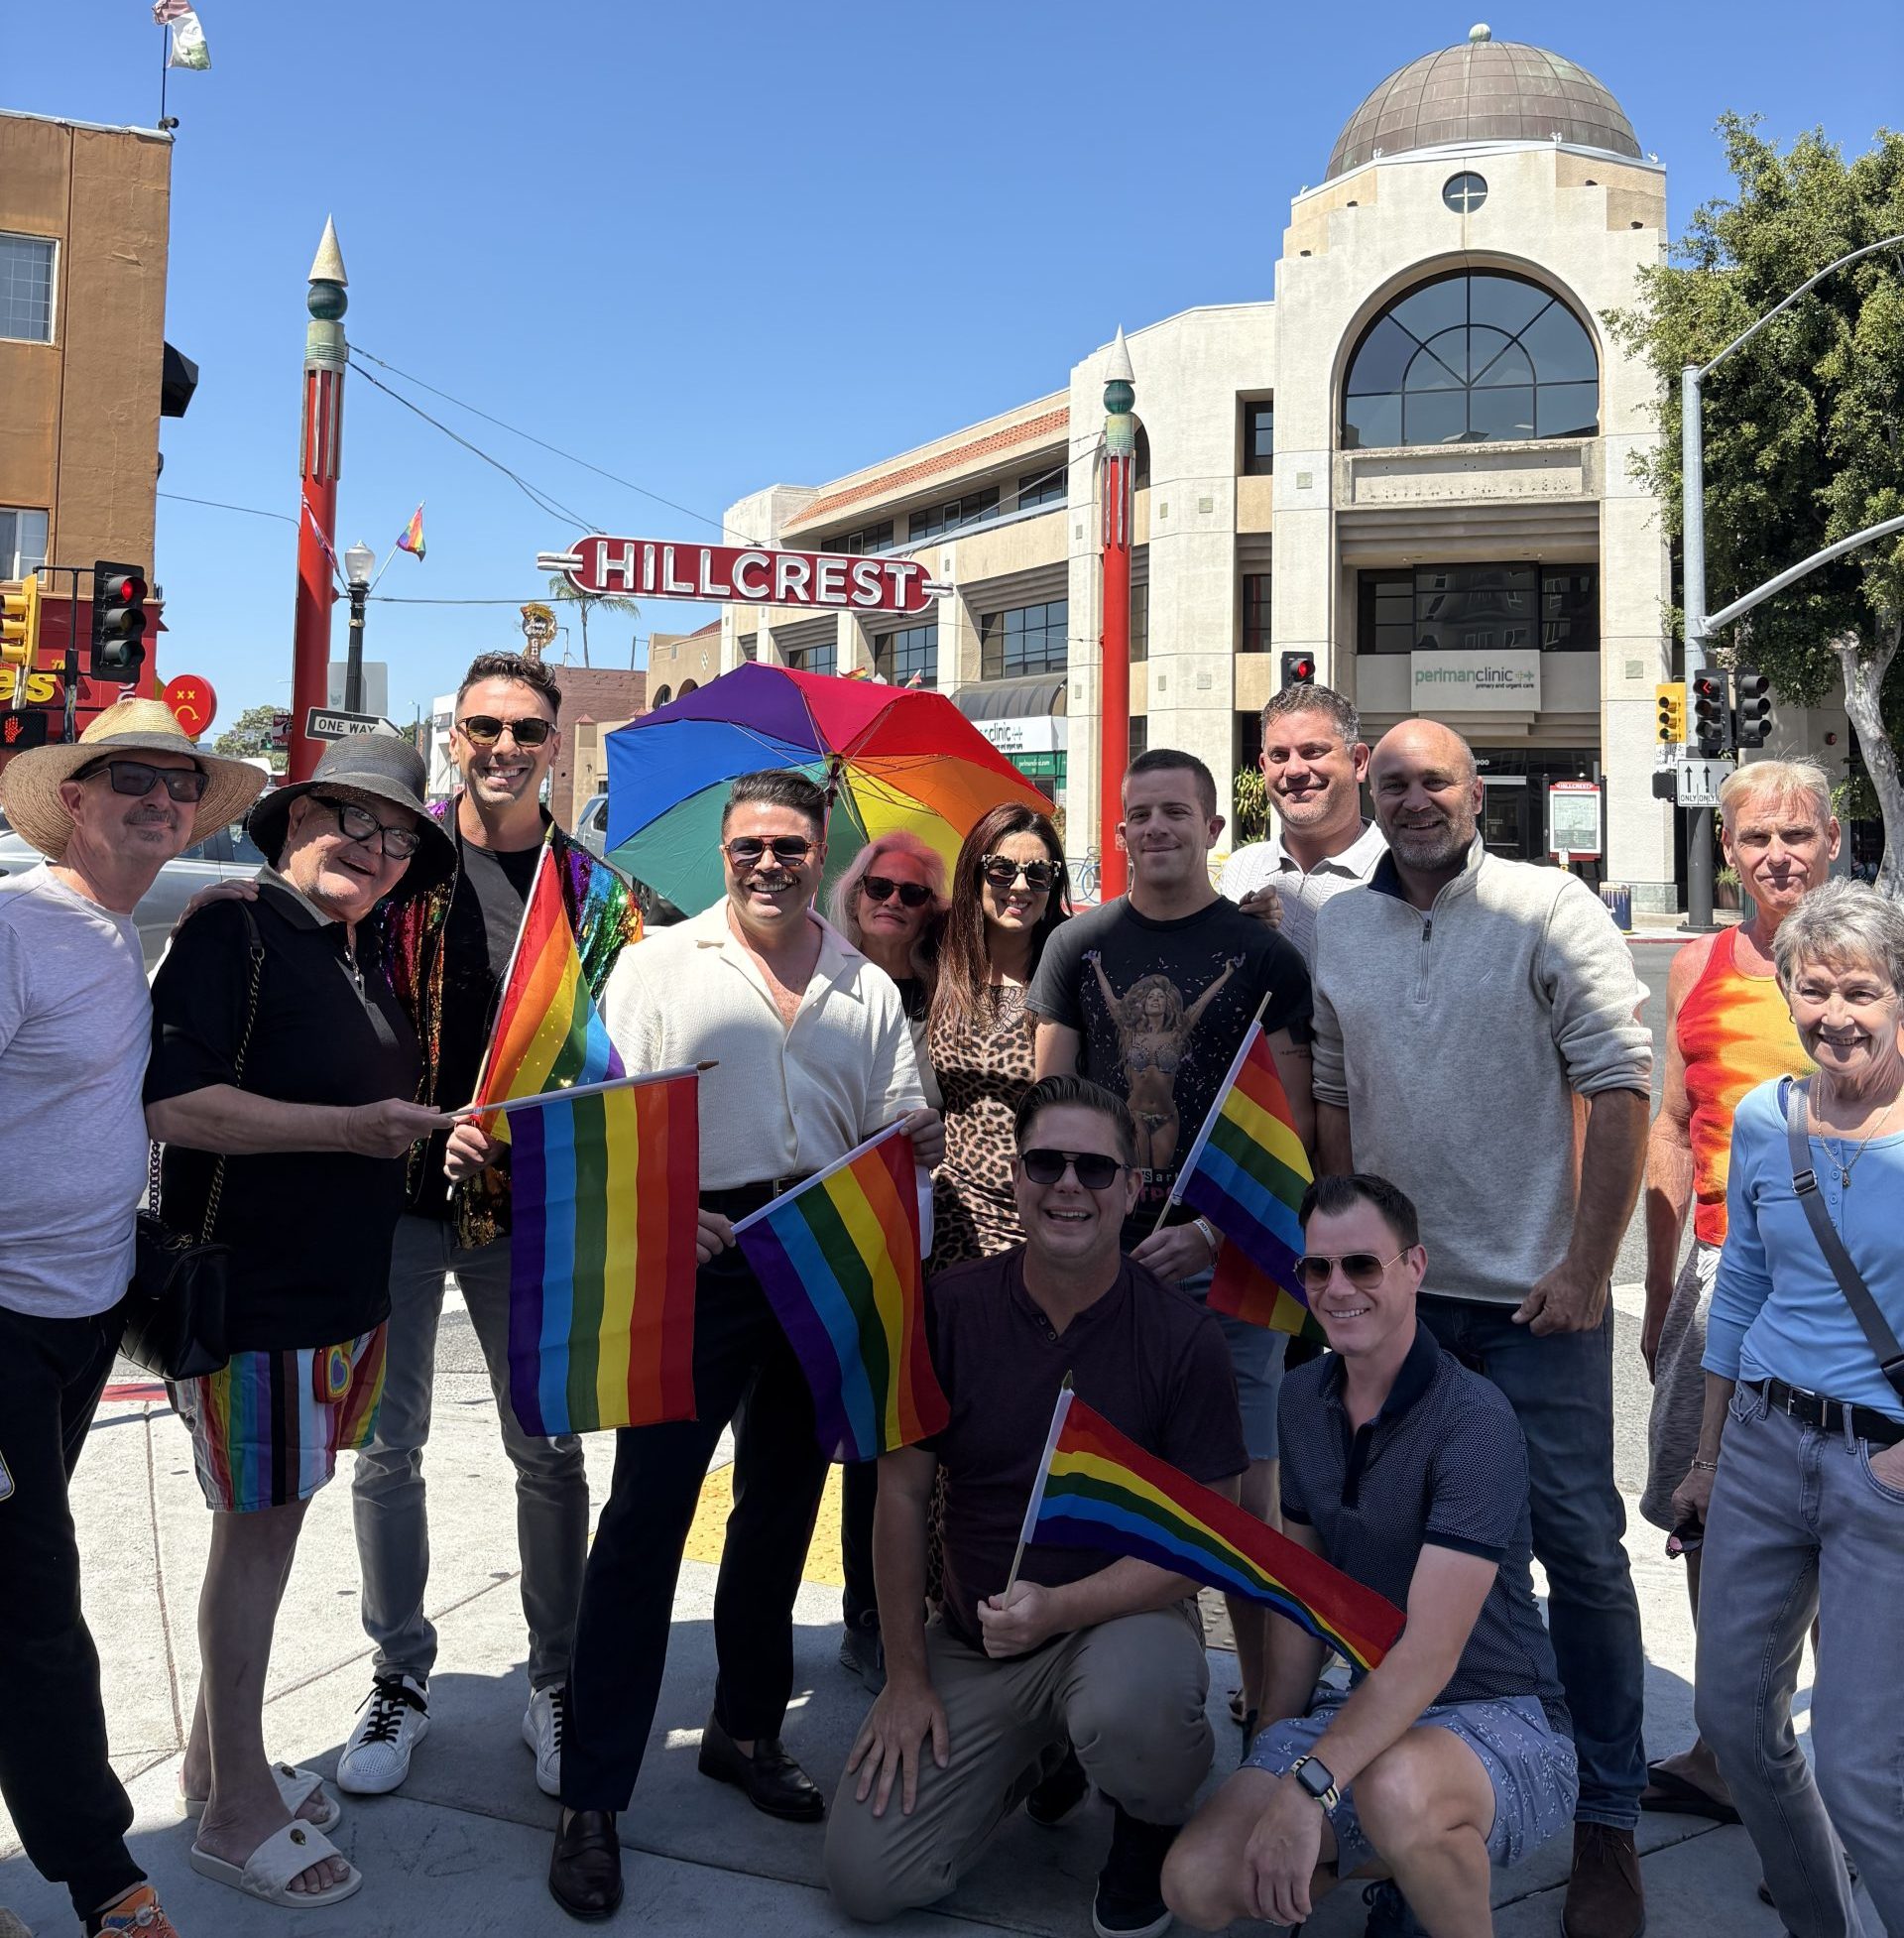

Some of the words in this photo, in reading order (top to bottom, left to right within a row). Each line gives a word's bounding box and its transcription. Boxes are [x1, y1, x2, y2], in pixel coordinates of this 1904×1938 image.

[596, 541, 917, 608] HILLCREST
[1415, 666, 1513, 685] perlmanclinic
[318, 718, 344, 732] ONE
[349, 722, 376, 735] WAY
[980, 722, 1012, 742] clinic
